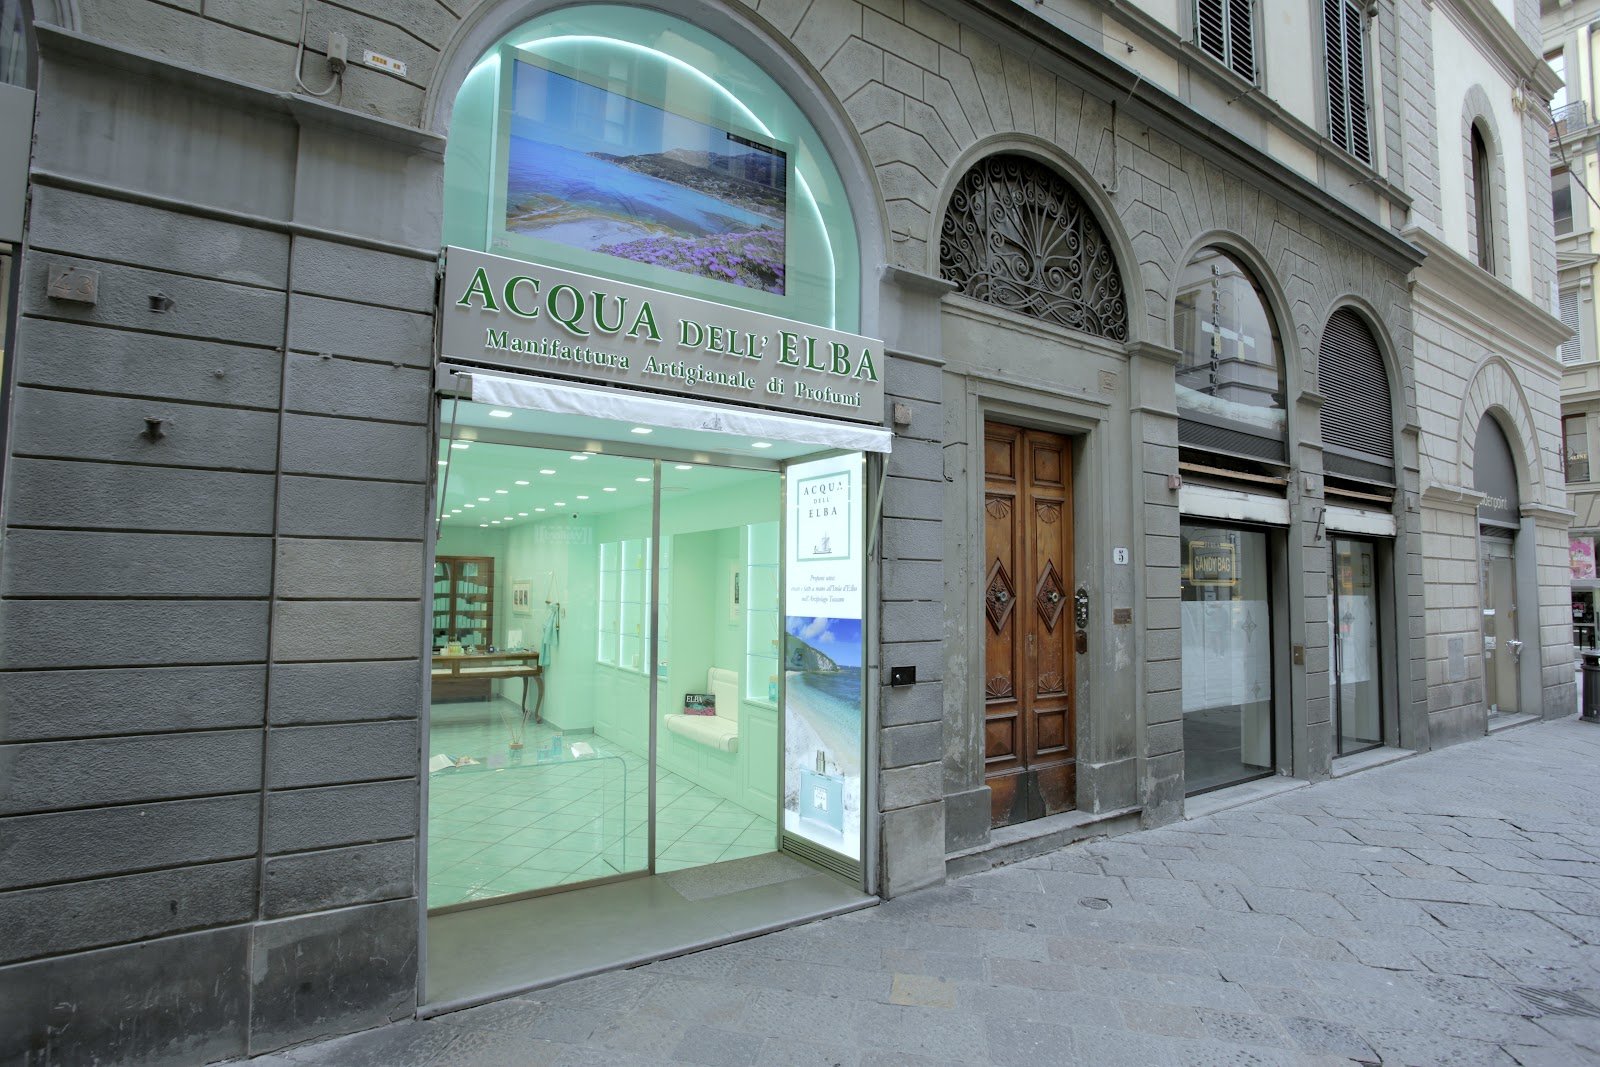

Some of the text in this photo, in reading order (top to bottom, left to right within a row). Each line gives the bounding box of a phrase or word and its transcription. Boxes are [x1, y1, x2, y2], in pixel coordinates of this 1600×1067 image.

[456, 266, 662, 342] ACQUA
[778, 330, 879, 382] ELBA
[485, 328, 861, 407] Manifattura Artigianale di Profumi
[808, 506, 837, 518] ELBA
[1118, 549, 1124, 563] 5
[1194, 556, 1231, 573] CANDY BAG
[686, 695, 703, 703] ELBA
